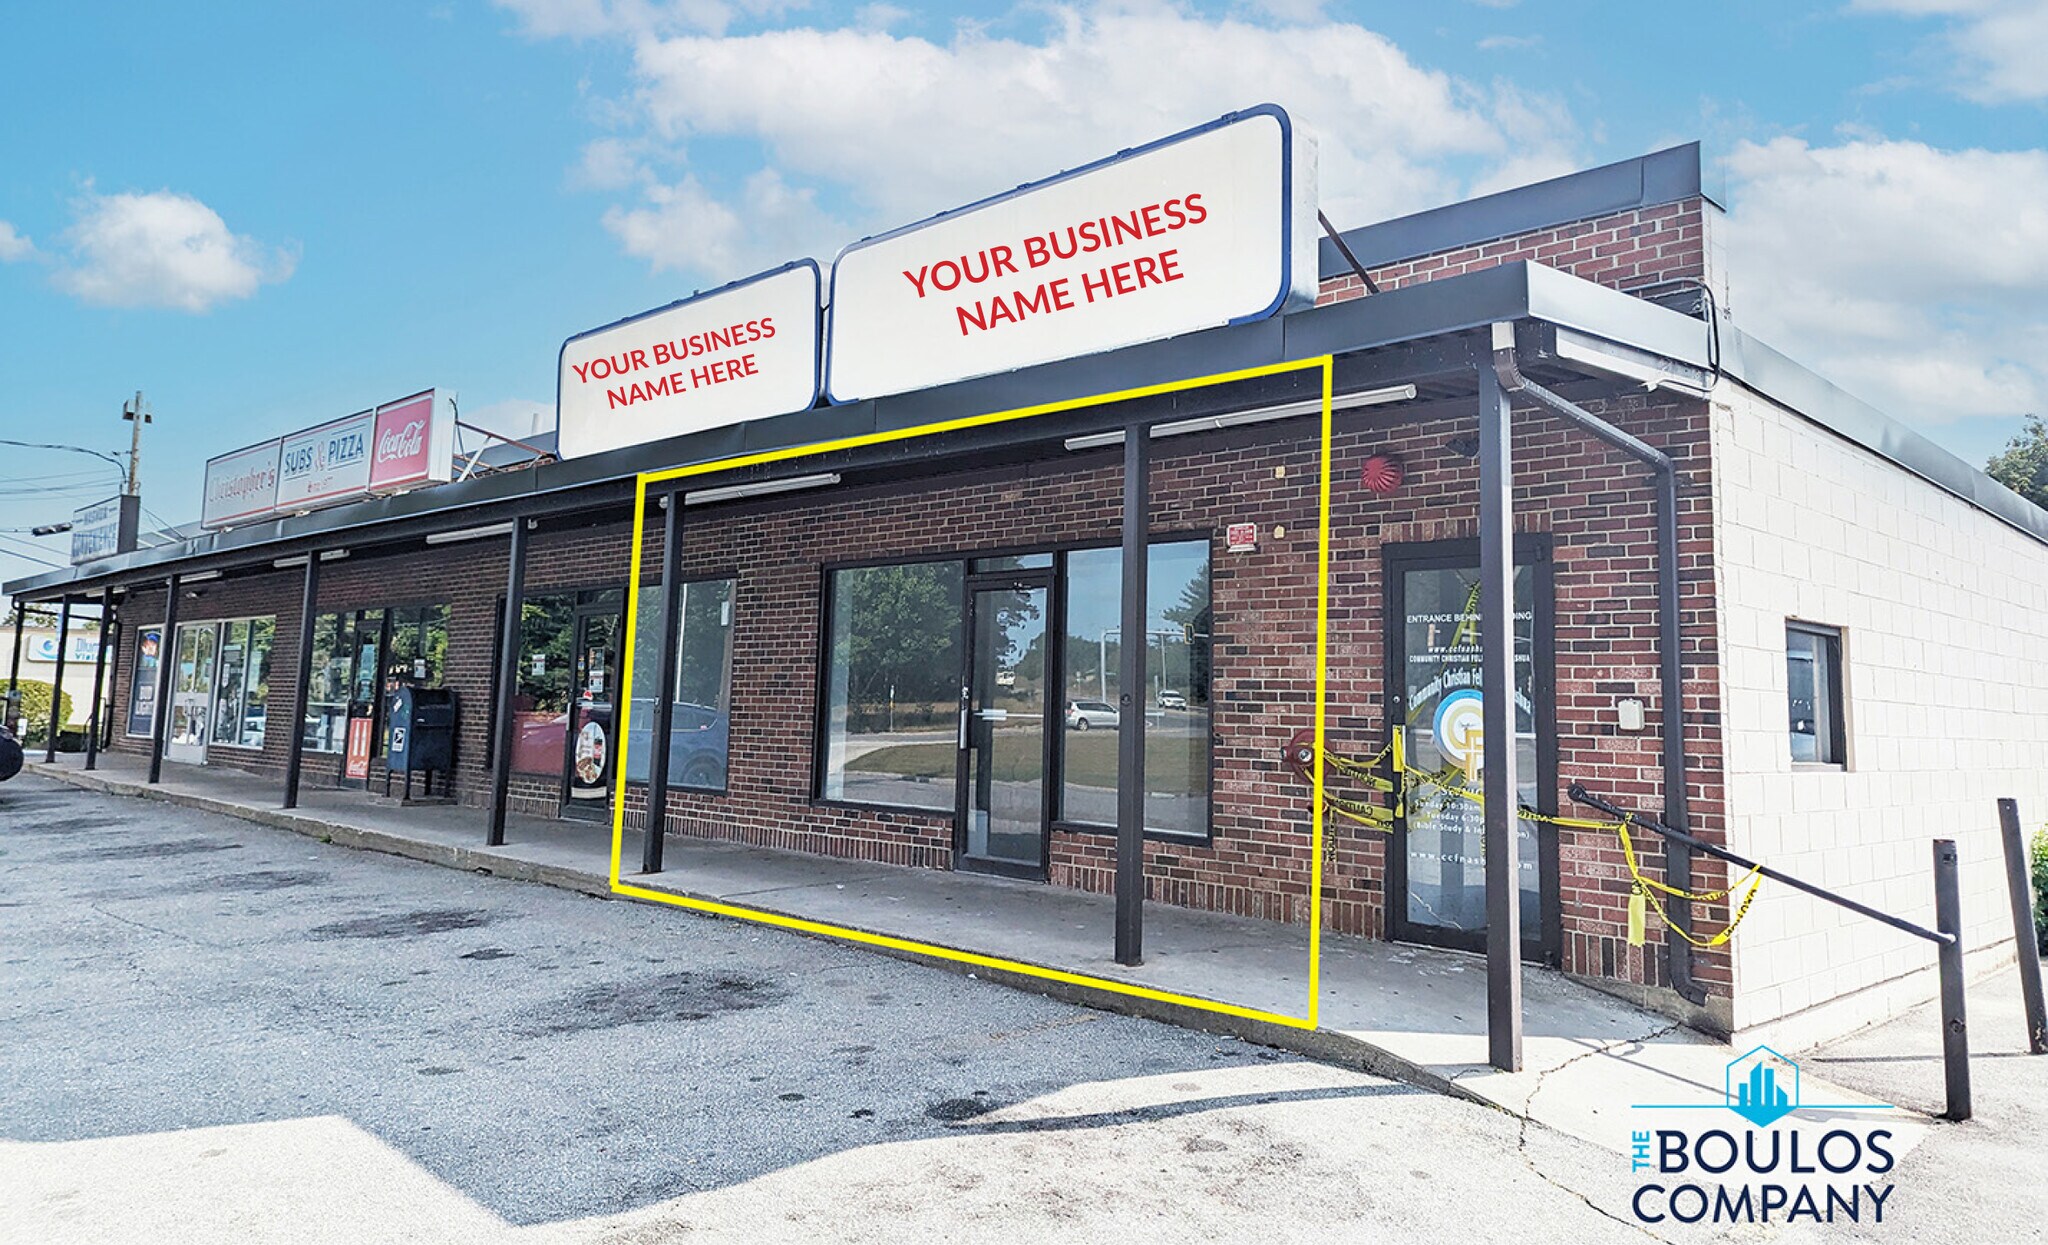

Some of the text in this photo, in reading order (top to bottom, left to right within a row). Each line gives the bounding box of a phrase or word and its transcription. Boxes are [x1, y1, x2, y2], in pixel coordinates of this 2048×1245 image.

[284, 446, 313, 474] SUBS
[328, 433, 364, 466] PIZZA
[1406, 614, 1452, 623] ENTRANCE
[1454, 613, 1483, 622] BEHIN
[1409, 655, 1440, 663] COMMUNITY
[1441, 654, 1469, 662] CHRISTIAN
[1408, 675, 1442, 711] Community
[1443, 667, 1470, 688] Christian
[1440, 823, 1463, 834] Study
